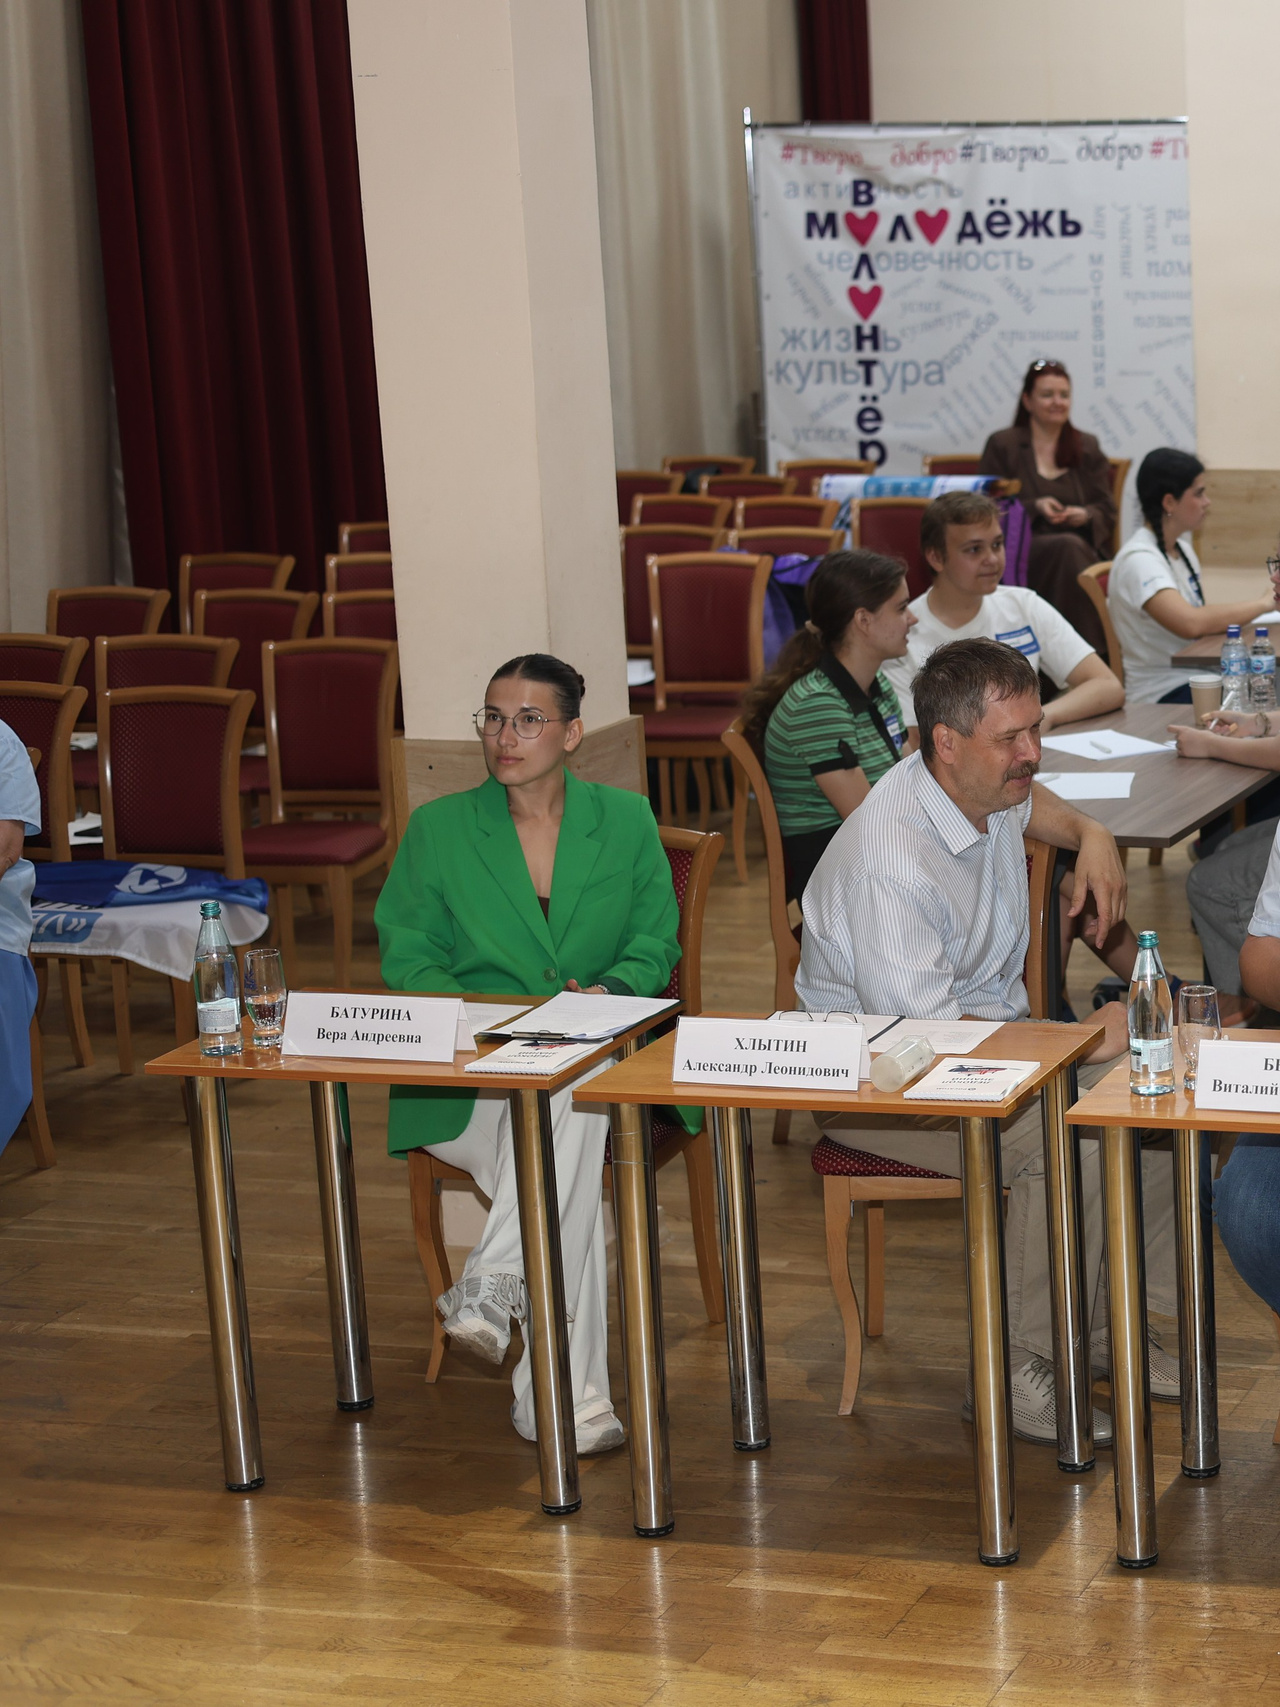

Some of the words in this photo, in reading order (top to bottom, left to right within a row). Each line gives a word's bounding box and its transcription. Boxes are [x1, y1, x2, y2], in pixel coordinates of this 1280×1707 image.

[890, 140, 958, 173] добро
[1076, 136, 1143, 171] добро
[783, 180, 963, 200] актиность
[817, 249, 1035, 273] чеовечность
[780, 326, 902, 352] жизь
[774, 359, 946, 395] кульура
[330, 1006, 412, 1021] БАТУРИНА
[316, 1027, 347, 1044] Вера
[351, 1029, 422, 1045] Андреевна
[734, 1037, 807, 1053] ХЛЫТИН
[682, 1058, 758, 1077] Александр
[760, 1061, 849, 1078] Леонидович
[1212, 1078, 1279, 1096] Виталий
